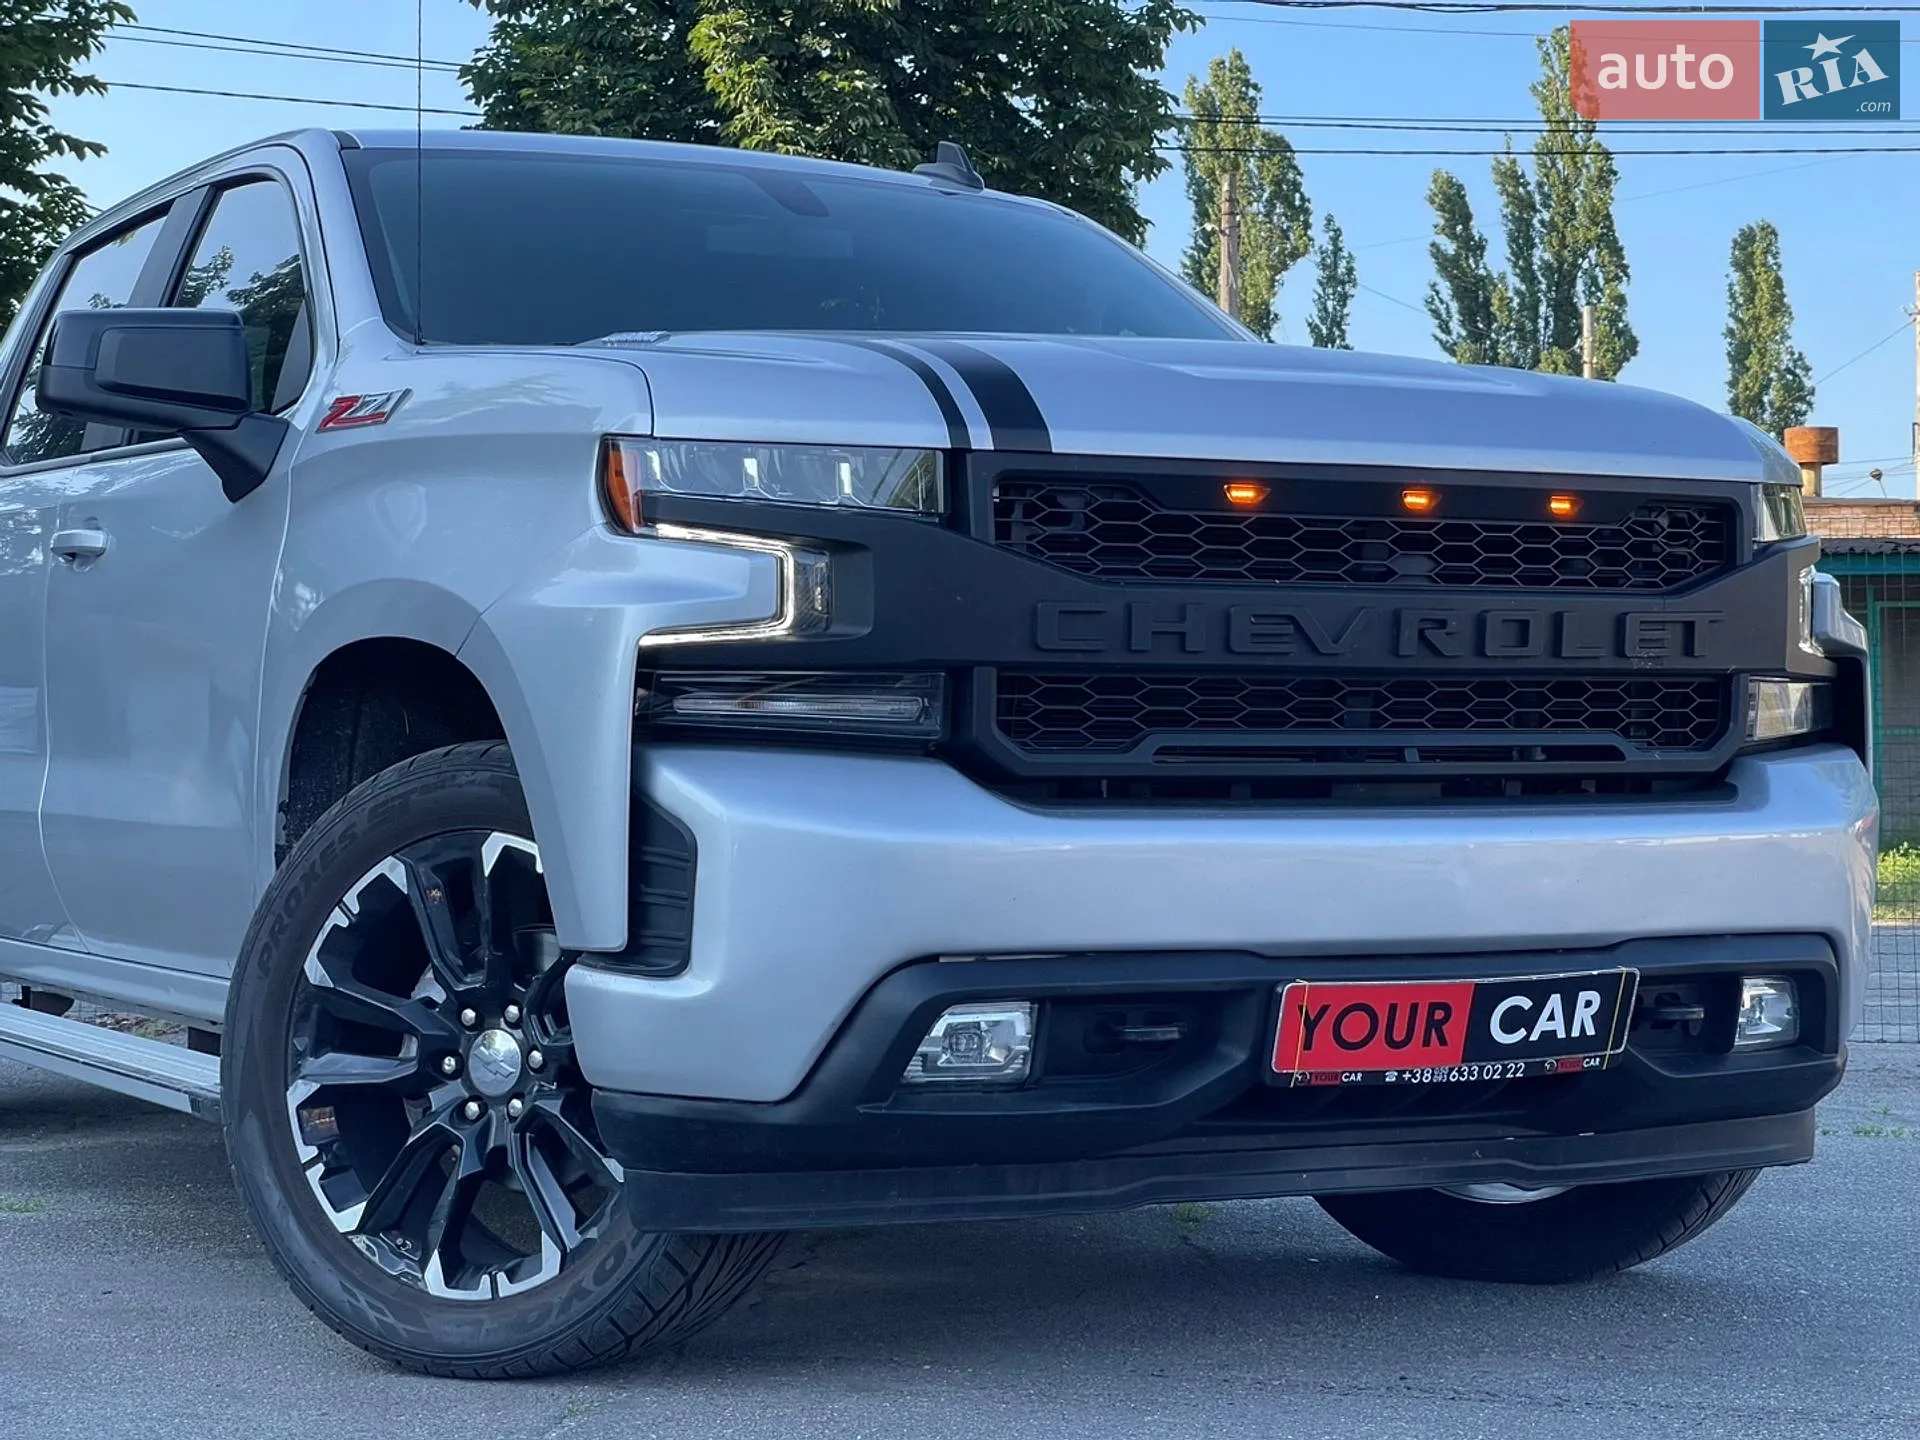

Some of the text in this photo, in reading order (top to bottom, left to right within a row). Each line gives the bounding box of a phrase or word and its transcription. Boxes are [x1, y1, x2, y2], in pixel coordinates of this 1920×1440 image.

[1033, 601, 1725, 659] CHEVROLET
[257, 824, 360, 978] PROXES
[1297, 990, 1601, 1051] YOUR CAR
[1342, 1072, 1363, 1083] CAR
[1449, 1064, 1478, 1082] 633
[1483, 1064, 1502, 1080] 02
[1506, 1062, 1525, 1078] 22
